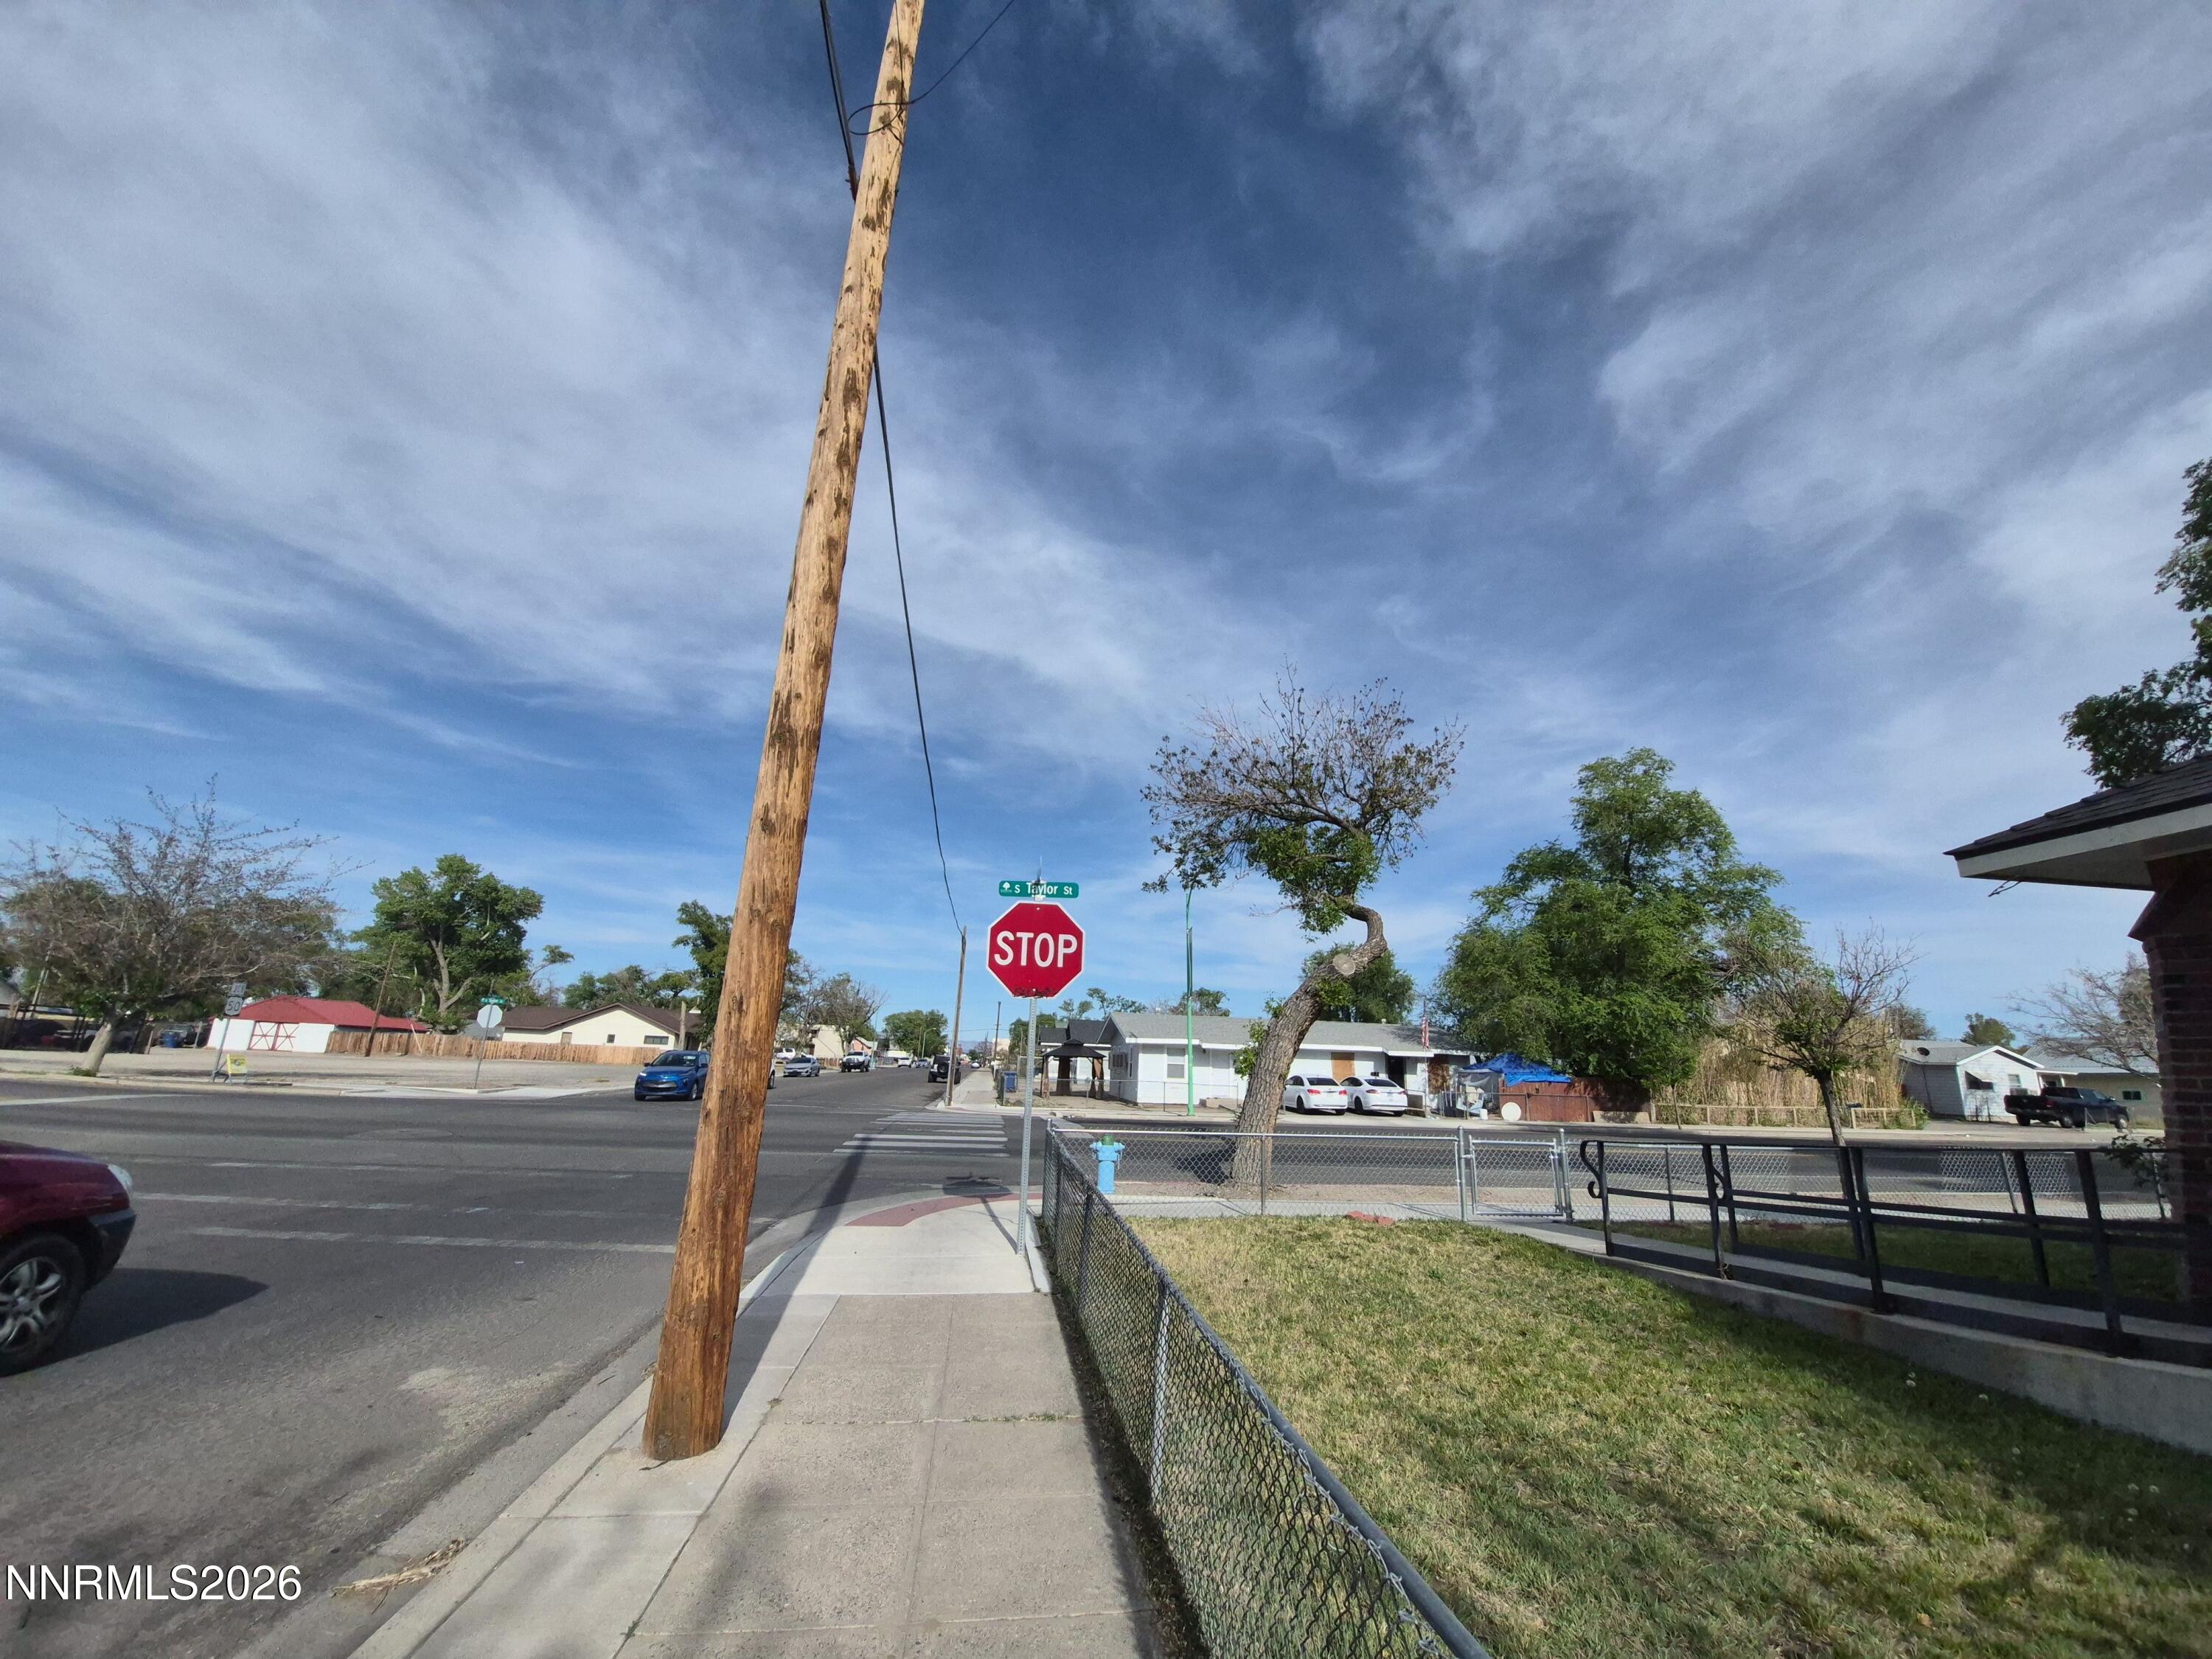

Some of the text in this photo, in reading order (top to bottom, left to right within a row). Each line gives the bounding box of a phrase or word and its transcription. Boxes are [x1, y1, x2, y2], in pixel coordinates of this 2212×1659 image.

[1015, 883, 1073, 895] S Taylor St
[994, 931, 1078, 968] STOP
[227, 1001, 240, 1011] 50
